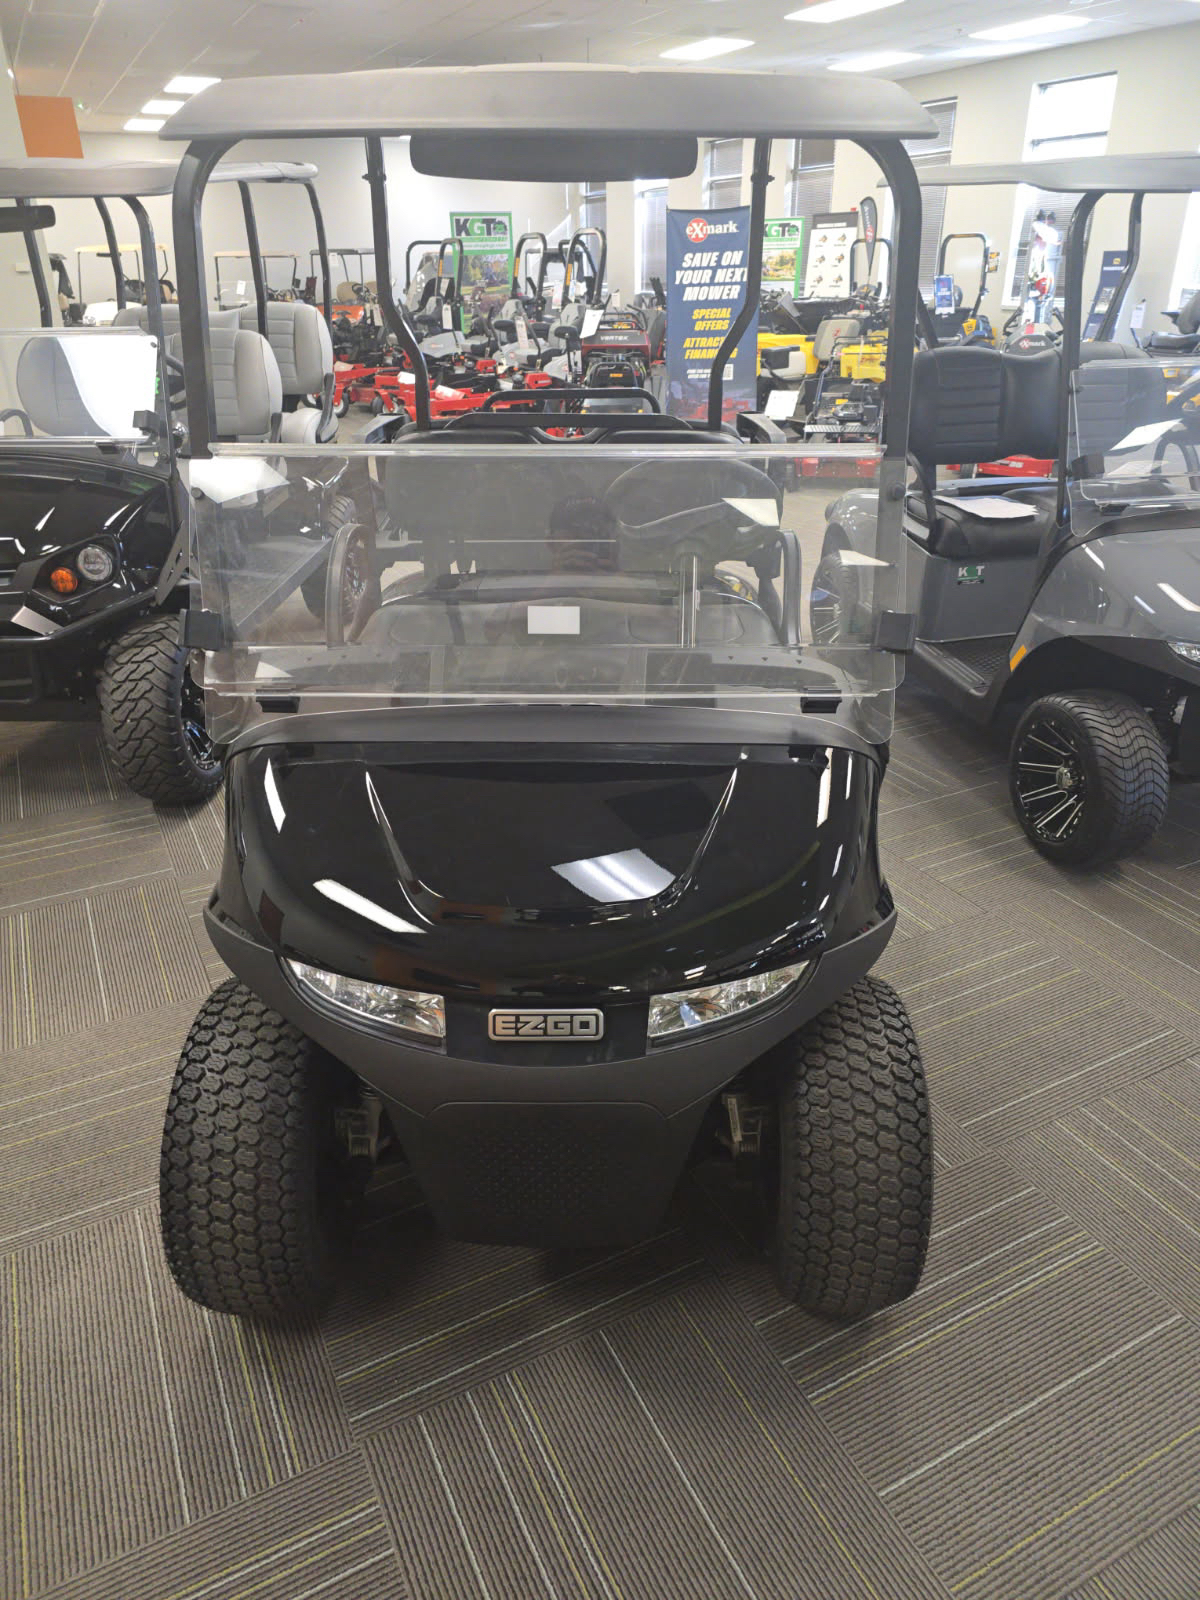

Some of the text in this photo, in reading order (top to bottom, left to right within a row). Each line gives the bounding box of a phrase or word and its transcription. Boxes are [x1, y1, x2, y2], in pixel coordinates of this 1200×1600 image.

[455, 218, 496, 236] KGT
[682, 250, 744, 268] SAVE ON
[674, 267, 748, 285] YOUR NEXT
[683, 285, 741, 301] MOWER
[692, 307, 732, 320] SPECIAL
[694, 319, 730, 331] OFFERS
[683, 336, 726, 348] ATTRACT
[684, 347, 738, 359] FINANG
[495, 1015, 596, 1036] EZGO
